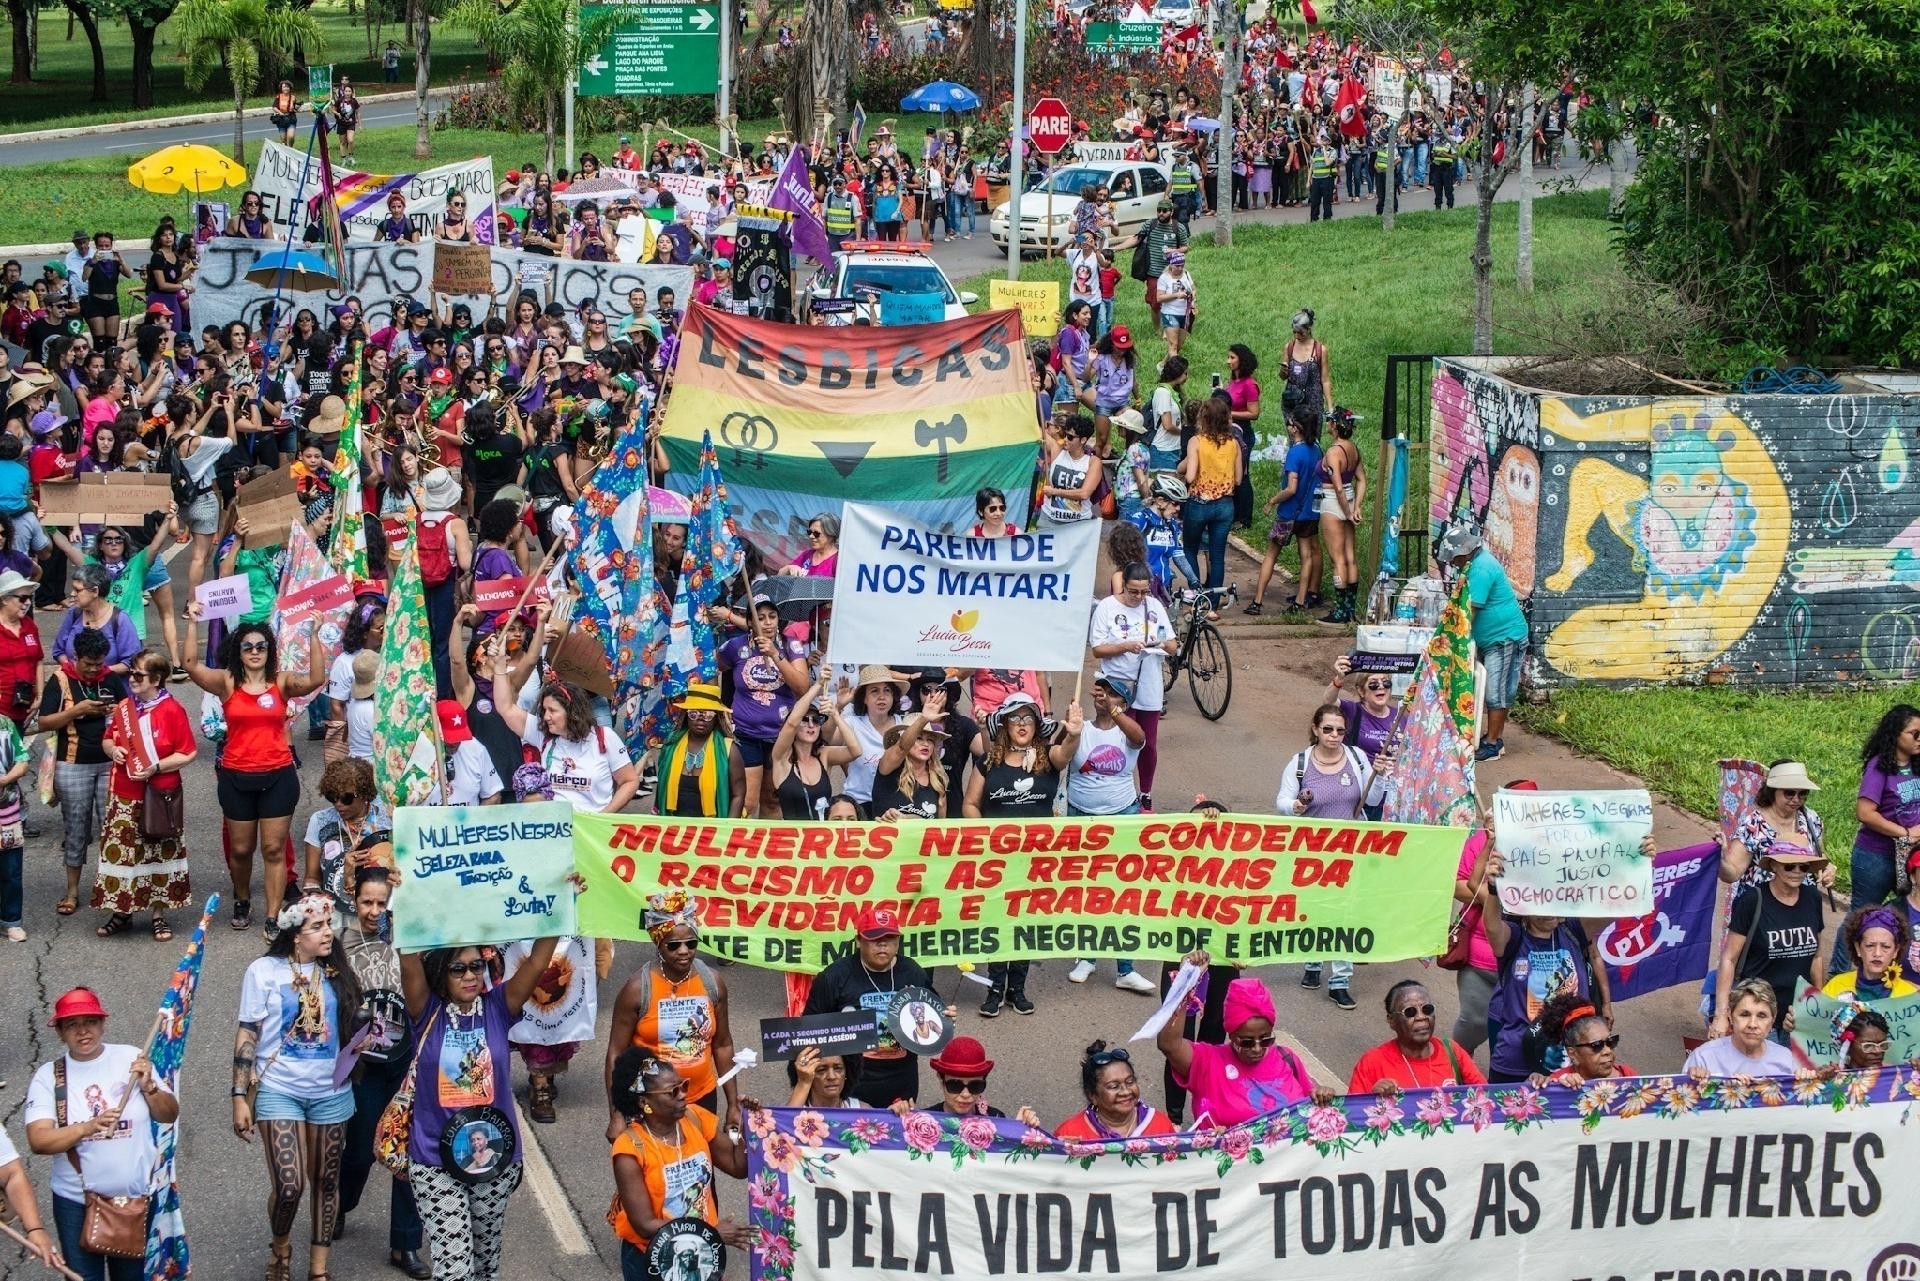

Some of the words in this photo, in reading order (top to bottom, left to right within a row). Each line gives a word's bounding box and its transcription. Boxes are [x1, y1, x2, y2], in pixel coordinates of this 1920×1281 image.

[1119, 23, 1154, 32] Cruzeiro
[1118, 34, 1153, 43] Indústria
[615, 57, 631, 66] LAGO
[631, 57, 641, 65] DO
[641, 57, 664, 65] PARQUE
[615, 66, 634, 74] PRAÇA
[615, 74, 642, 82] QUADRAS
[1031, 115, 1069, 136] PARE
[998, 287, 1047, 299] MULHERES
[698, 320, 1011, 390] LESBICAS
[881, 526, 996, 561] PAREM
[1010, 534, 1054, 562] DE
[334, 582, 350, 596] MAIS
[856, 563, 925, 594] NOS
[937, 567, 1071, 602] MATAR!
[950, 633, 992, 652] Bessa
[1501, 799, 1586, 823] MULHERES
[1593, 803, 1653, 820] NEGRAS
[418, 823, 509, 850] MULHERES
[608, 823, 899, 860] MULHERES
[919, 824, 1114, 857] NEGRAS
[1139, 821, 1407, 856] CONDENAM
[611, 855, 636, 883] O
[658, 861, 874, 897] RACISMO
[896, 863, 927, 893] E
[945, 859, 1006, 890] AS
[1027, 853, 1277, 890] REFORMAS
[1291, 857, 1354, 888] DA
[1556, 864, 1610, 884] JUSTO
[518, 875, 534, 895] &
[960, 894, 985, 920] E
[1004, 886, 1307, 925] TRABALHISTA.
[764, 937, 803, 963] DE
[1013, 924, 1141, 953] NEGRAS
[1176, 926, 1212, 951] DF
[1225, 933, 1240, 958] E
[1249, 926, 1375, 957] ENTORNO
[1615, 922, 1645, 957] PT
[1767, 926, 1817, 949] PUTA
[660, 998, 697, 1008] FRENTE
[770, 1031, 790, 1039] CADA
[797, 1027, 829, 1037] SEGUNDO
[830, 1026, 846, 1034] UMA
[847, 1023, 875, 1033] MULHER
[792, 1036, 817, 1047] VÍTIMA
[817, 1035, 828, 1043] DE
[828, 1032, 857, 1043] ASSÉDIO
[814, 1186, 955, 1275] PELA
[974, 1192, 1120, 1275] VIDA
[1152, 1187, 1222, 1273] DE
[1259, 1167, 1447, 1259] TODAS
[1471, 1160, 1540, 1240] AS
[1571, 1132, 1884, 1230] MULHERES
[671, 1222, 697, 1235] MARIA
[702, 1229, 714, 1241] DE
